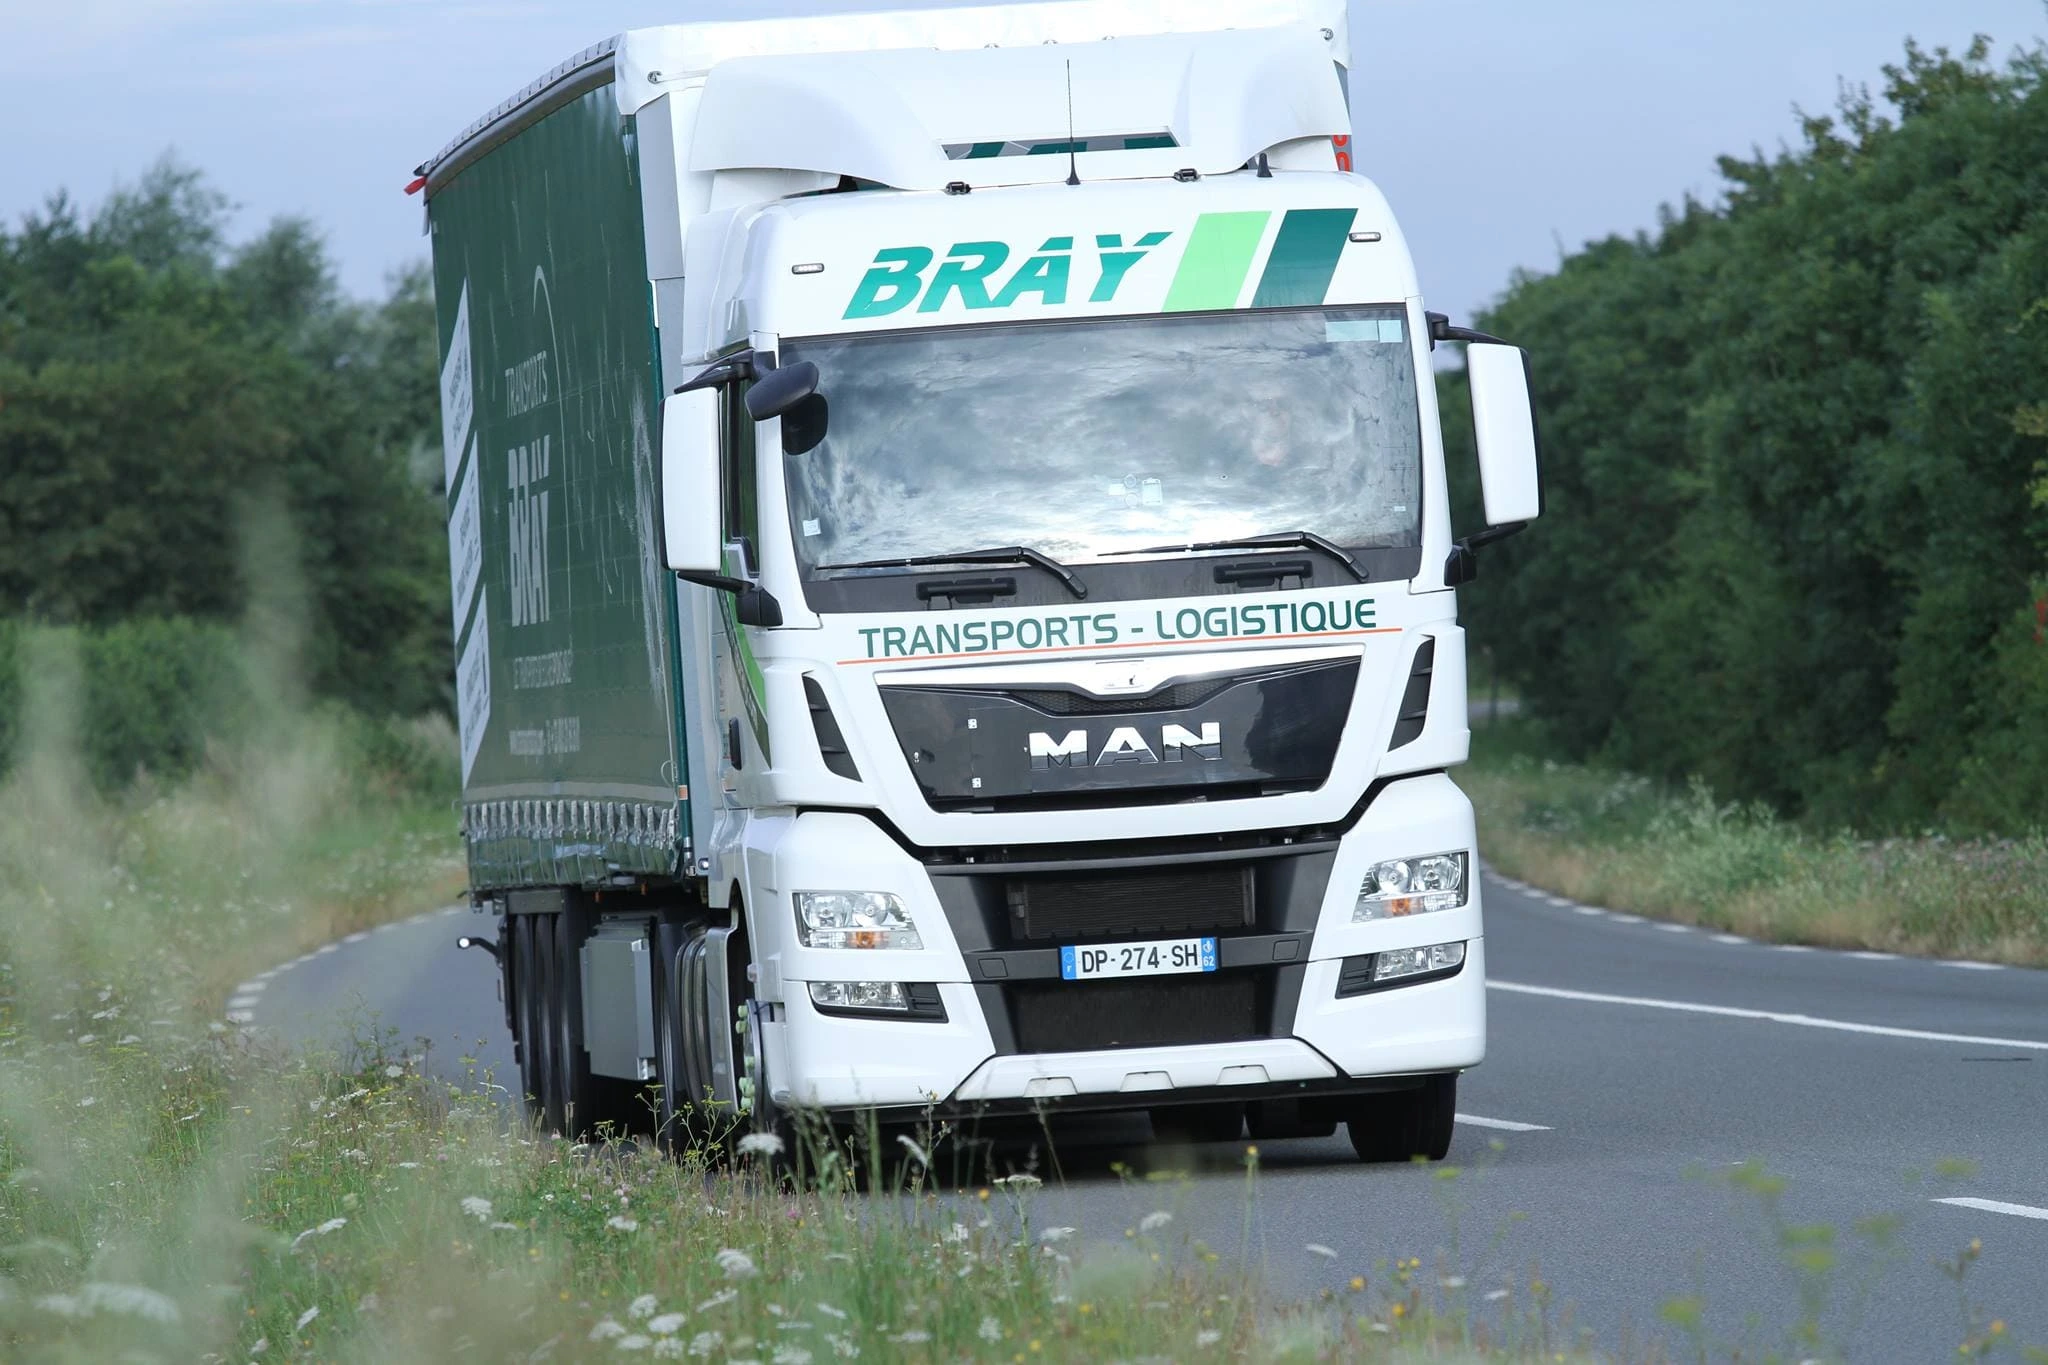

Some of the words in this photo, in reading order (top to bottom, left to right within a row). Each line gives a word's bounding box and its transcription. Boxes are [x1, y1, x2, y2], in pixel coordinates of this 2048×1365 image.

[841, 231, 1174, 320] BRAY
[508, 434, 550, 627] BRAY
[858, 613, 1119, 658] TRANSPORTS
[1155, 598, 1377, 640] LOGISTIQUE
[1028, 721, 1222, 771] MAN
[1081, 944, 1198, 973] DP-274-SH
[1203, 956, 1215, 967] 62
